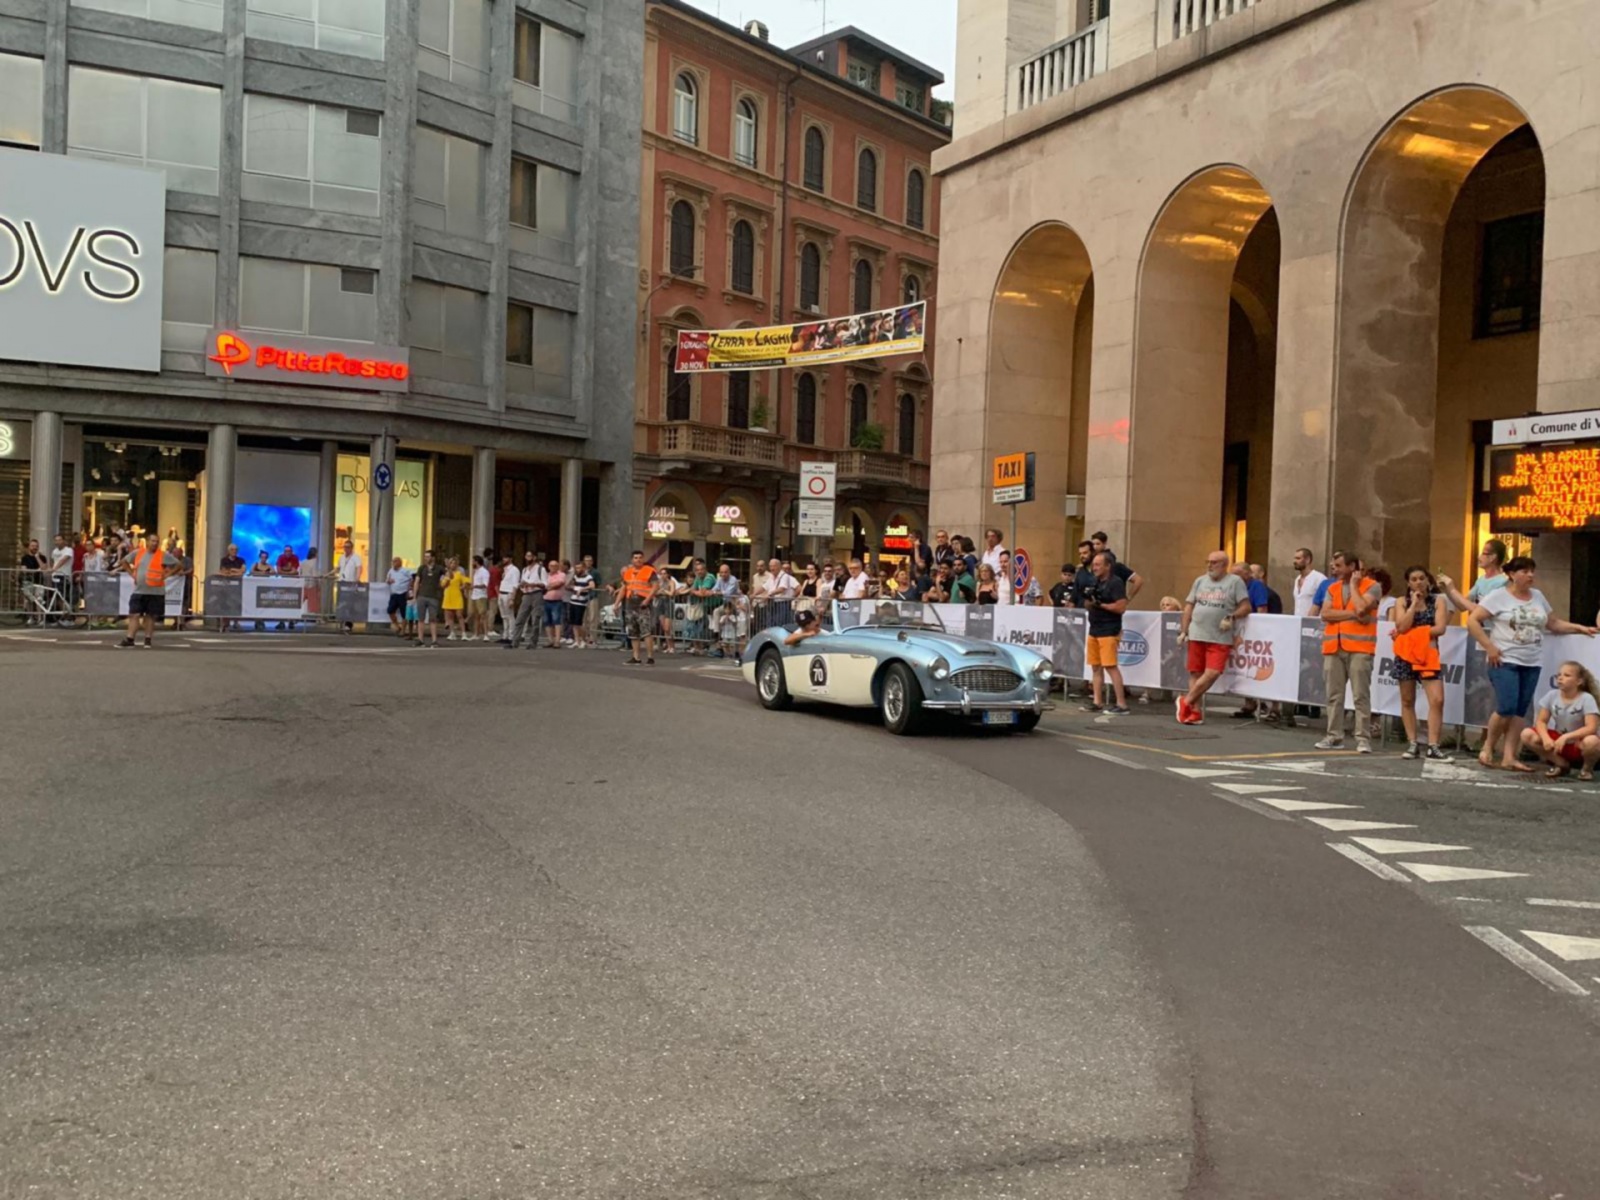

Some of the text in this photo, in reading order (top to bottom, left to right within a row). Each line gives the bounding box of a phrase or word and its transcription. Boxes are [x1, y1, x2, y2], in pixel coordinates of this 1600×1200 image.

[711, 333, 745, 348] TERRA
[754, 331, 791, 347] LAGHI
[256, 346, 409, 381] PittaRosso
[1531, 422, 1577, 435] Comune
[1580, 417, 1592, 431] di
[1516, 448, 1600, 466] DAL 18 APRILE
[998, 460, 1021, 479] TAXI
[1515, 460, 1597, 476] AL 6 GENNAIO
[341, 475, 420, 498] DOAS
[1499, 474, 1529, 488] SEAN
[1534, 484, 1569, 495] VILLA
[1519, 493, 1574, 507] PIAZZALE
[1010, 630, 1053, 646] PALINI
[1244, 640, 1273, 656] FOX
[1228, 655, 1273, 670] TOWN
[812, 668, 824, 682] 70
